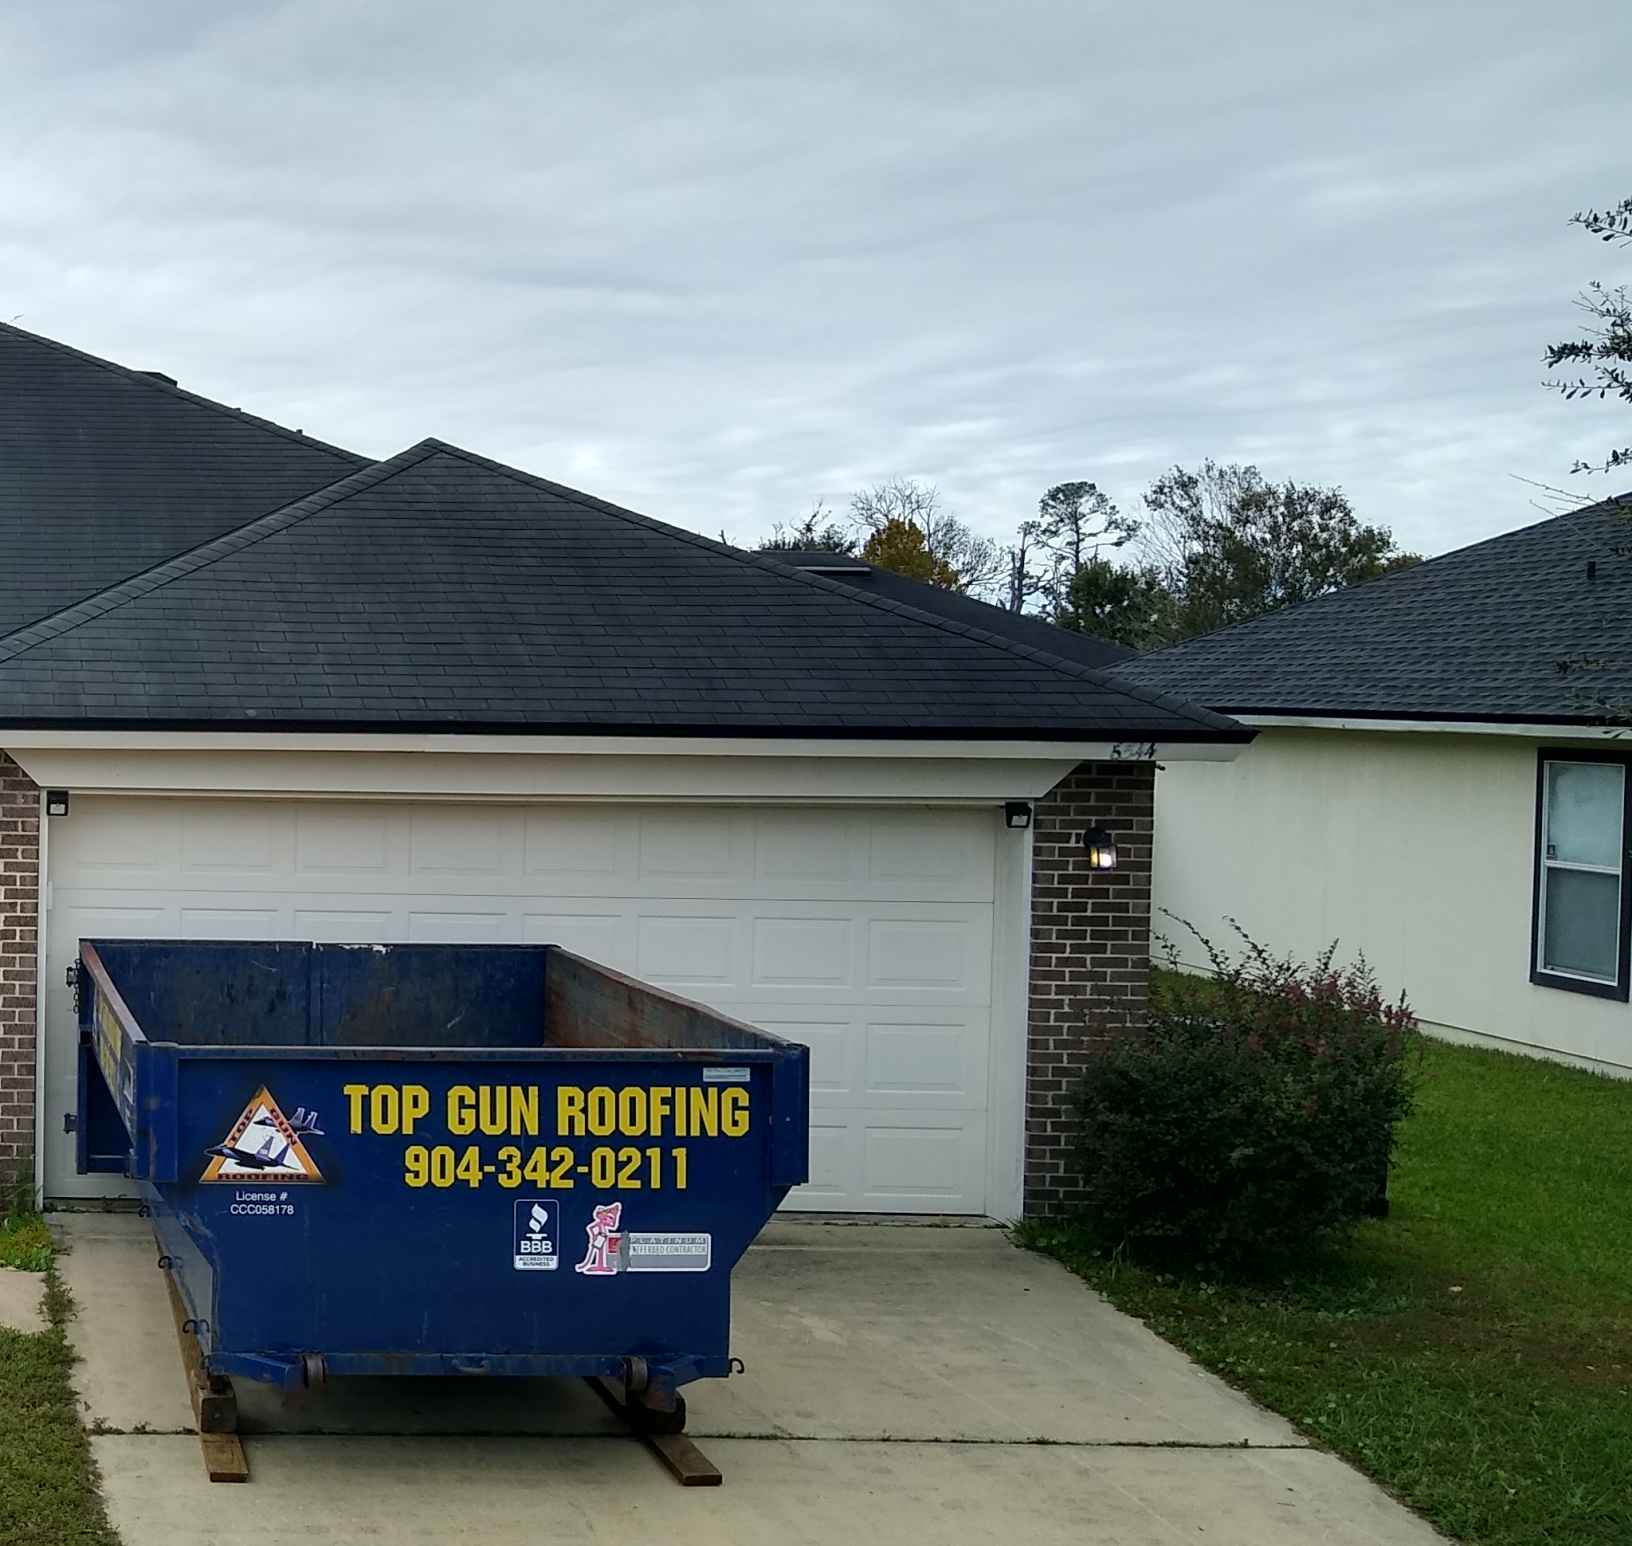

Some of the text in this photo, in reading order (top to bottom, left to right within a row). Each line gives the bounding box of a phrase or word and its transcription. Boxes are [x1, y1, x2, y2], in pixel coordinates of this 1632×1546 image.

[343, 1084, 750, 1137] TOP GUN ROOFING
[228, 1107, 298, 1146] TOP GUN
[404, 1145, 687, 1190] 904-342-0211
[217, 1172, 309, 1182] ROOFING
[235, 1190, 288, 1201] License #
[229, 1204, 295, 1215] CCC058178
[520, 1240, 553, 1253] BBB
[632, 1245, 706, 1254] EFERRED CONTRACTOR
